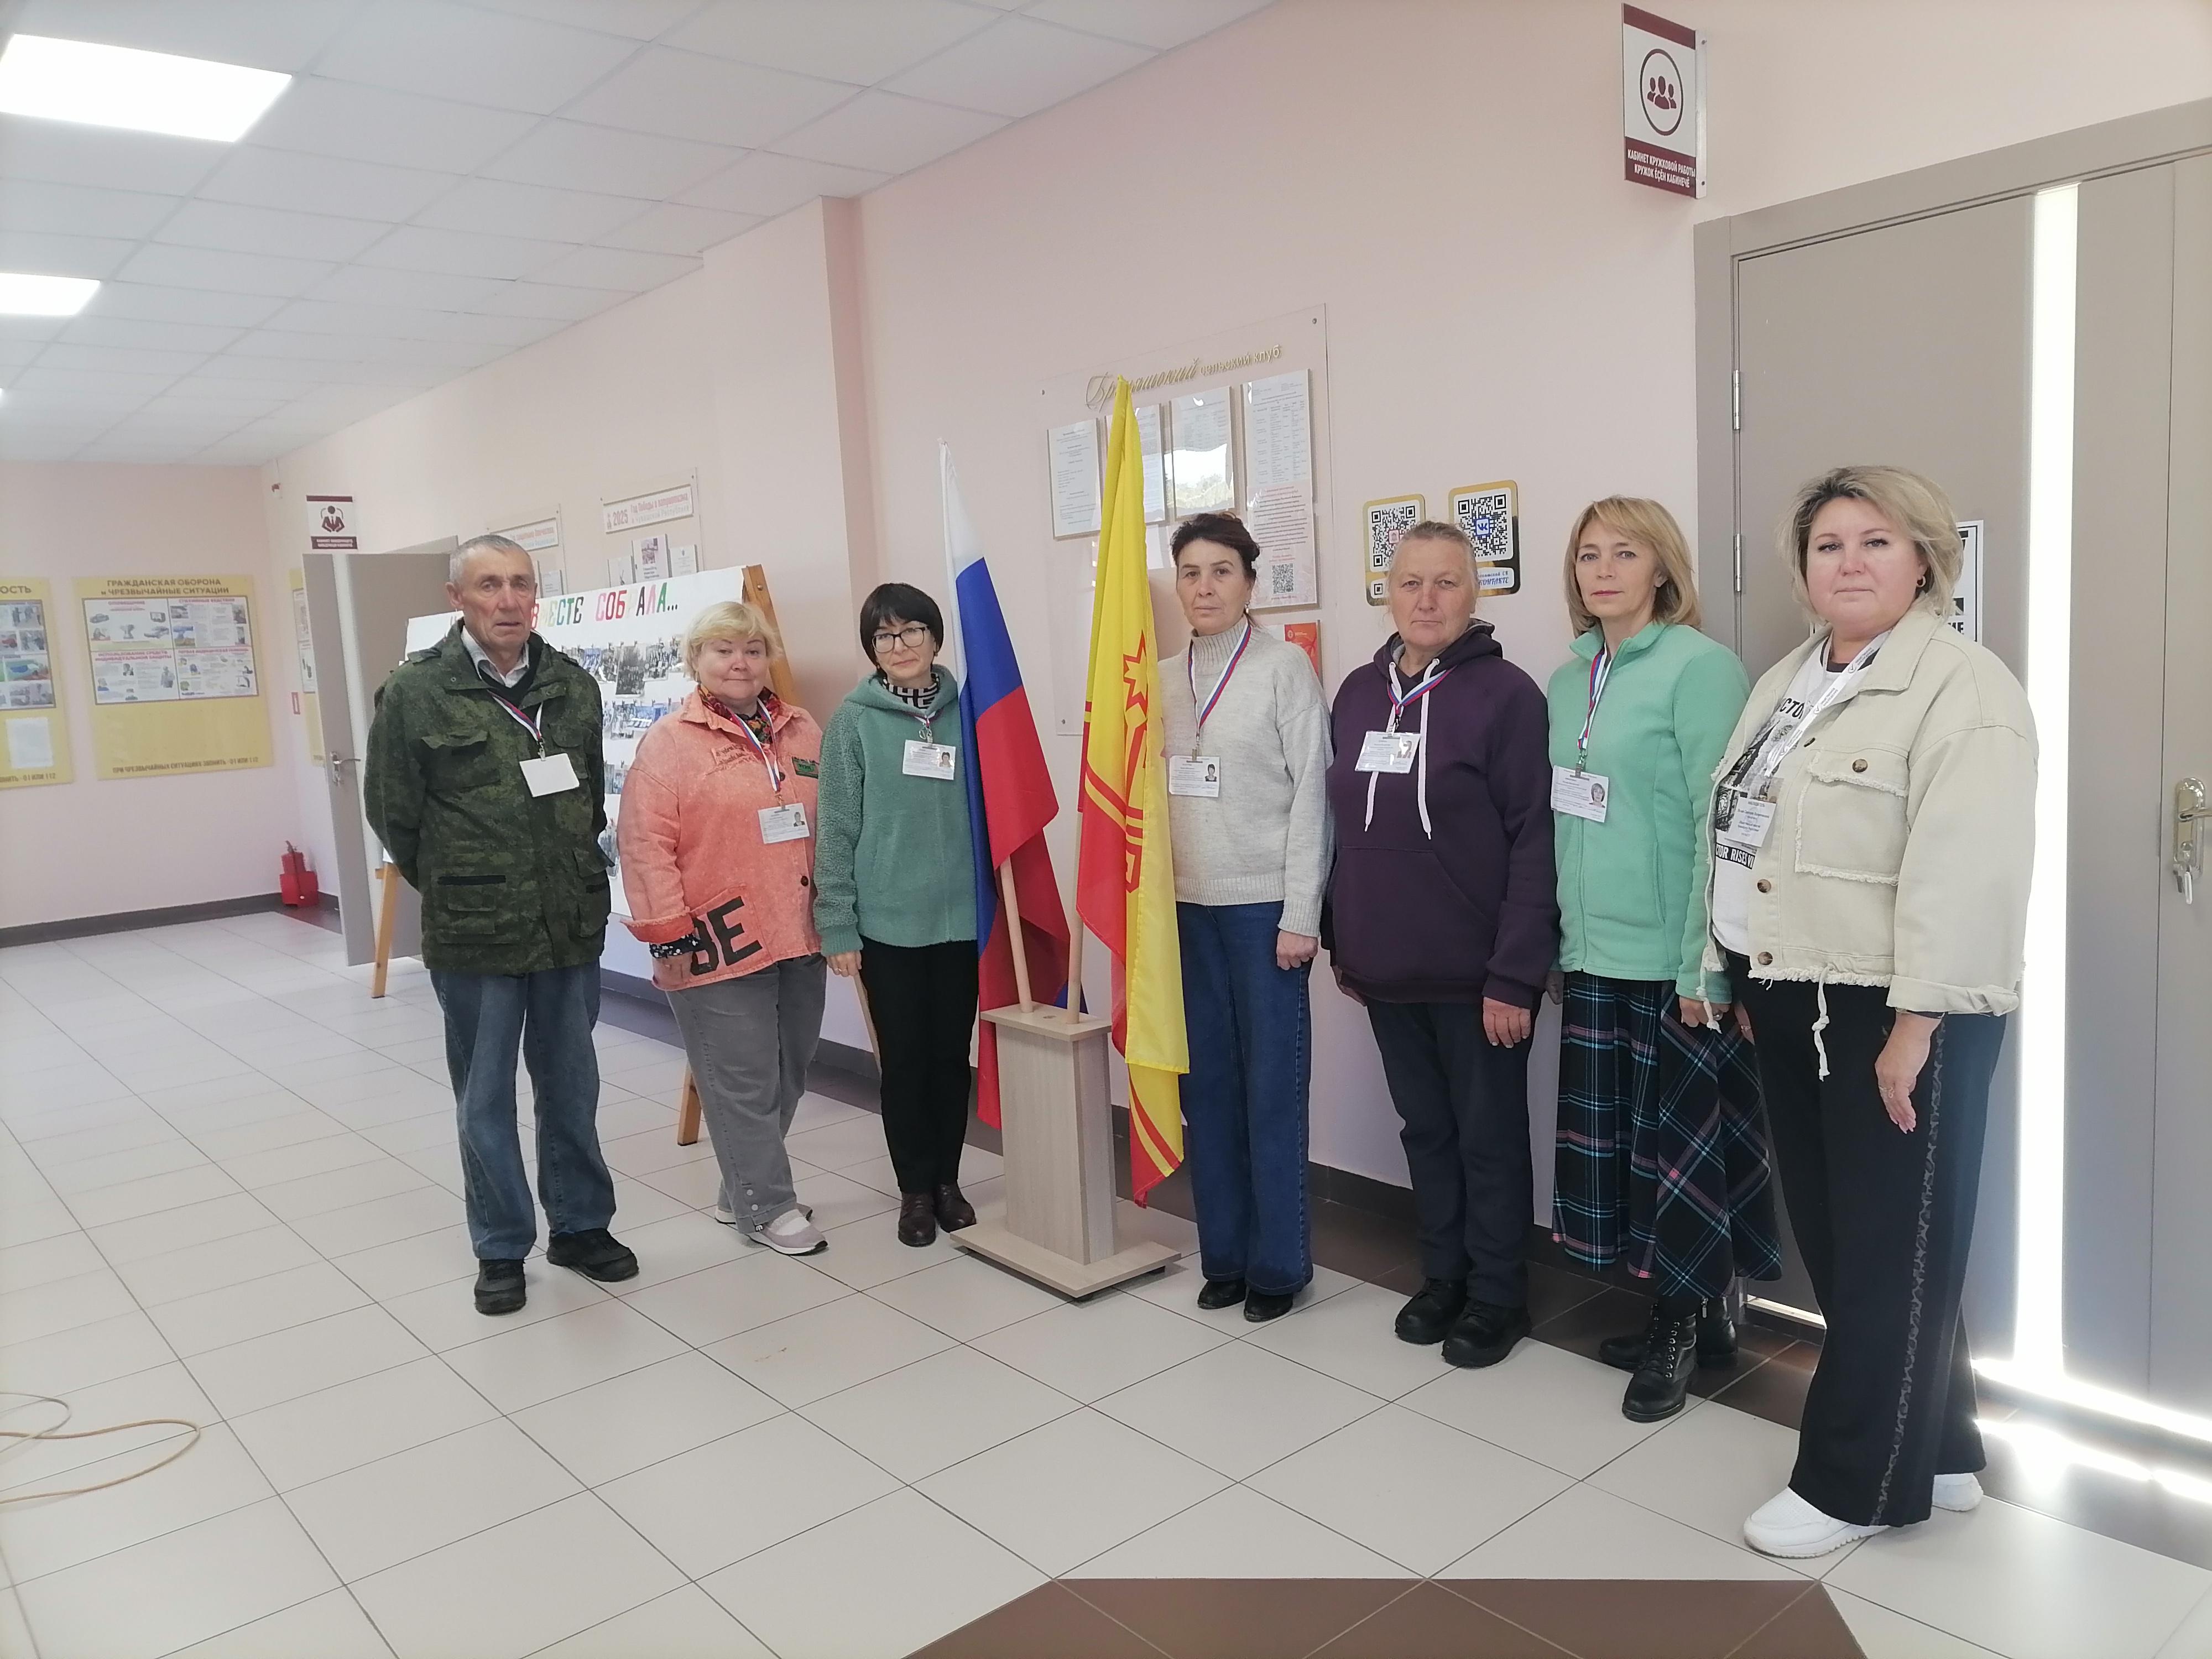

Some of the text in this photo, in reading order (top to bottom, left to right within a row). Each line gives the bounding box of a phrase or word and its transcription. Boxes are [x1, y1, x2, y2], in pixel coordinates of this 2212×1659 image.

[1627, 149, 1695, 178] КАБИНЕТ КРУЖКОВОЙ РАБОТЫ
[1634, 164, 1654, 179] КРУЖОК
[1201, 352, 1250, 377] сельский
[1253, 343, 1281, 363] клуб
[107, 578, 176, 587] ГРАЖДАНСКАЯ
[108, 587, 181, 596] ЧРЕЗВЫЧАЙНЫЕ
[1730, 848, 1748, 865] RISES
